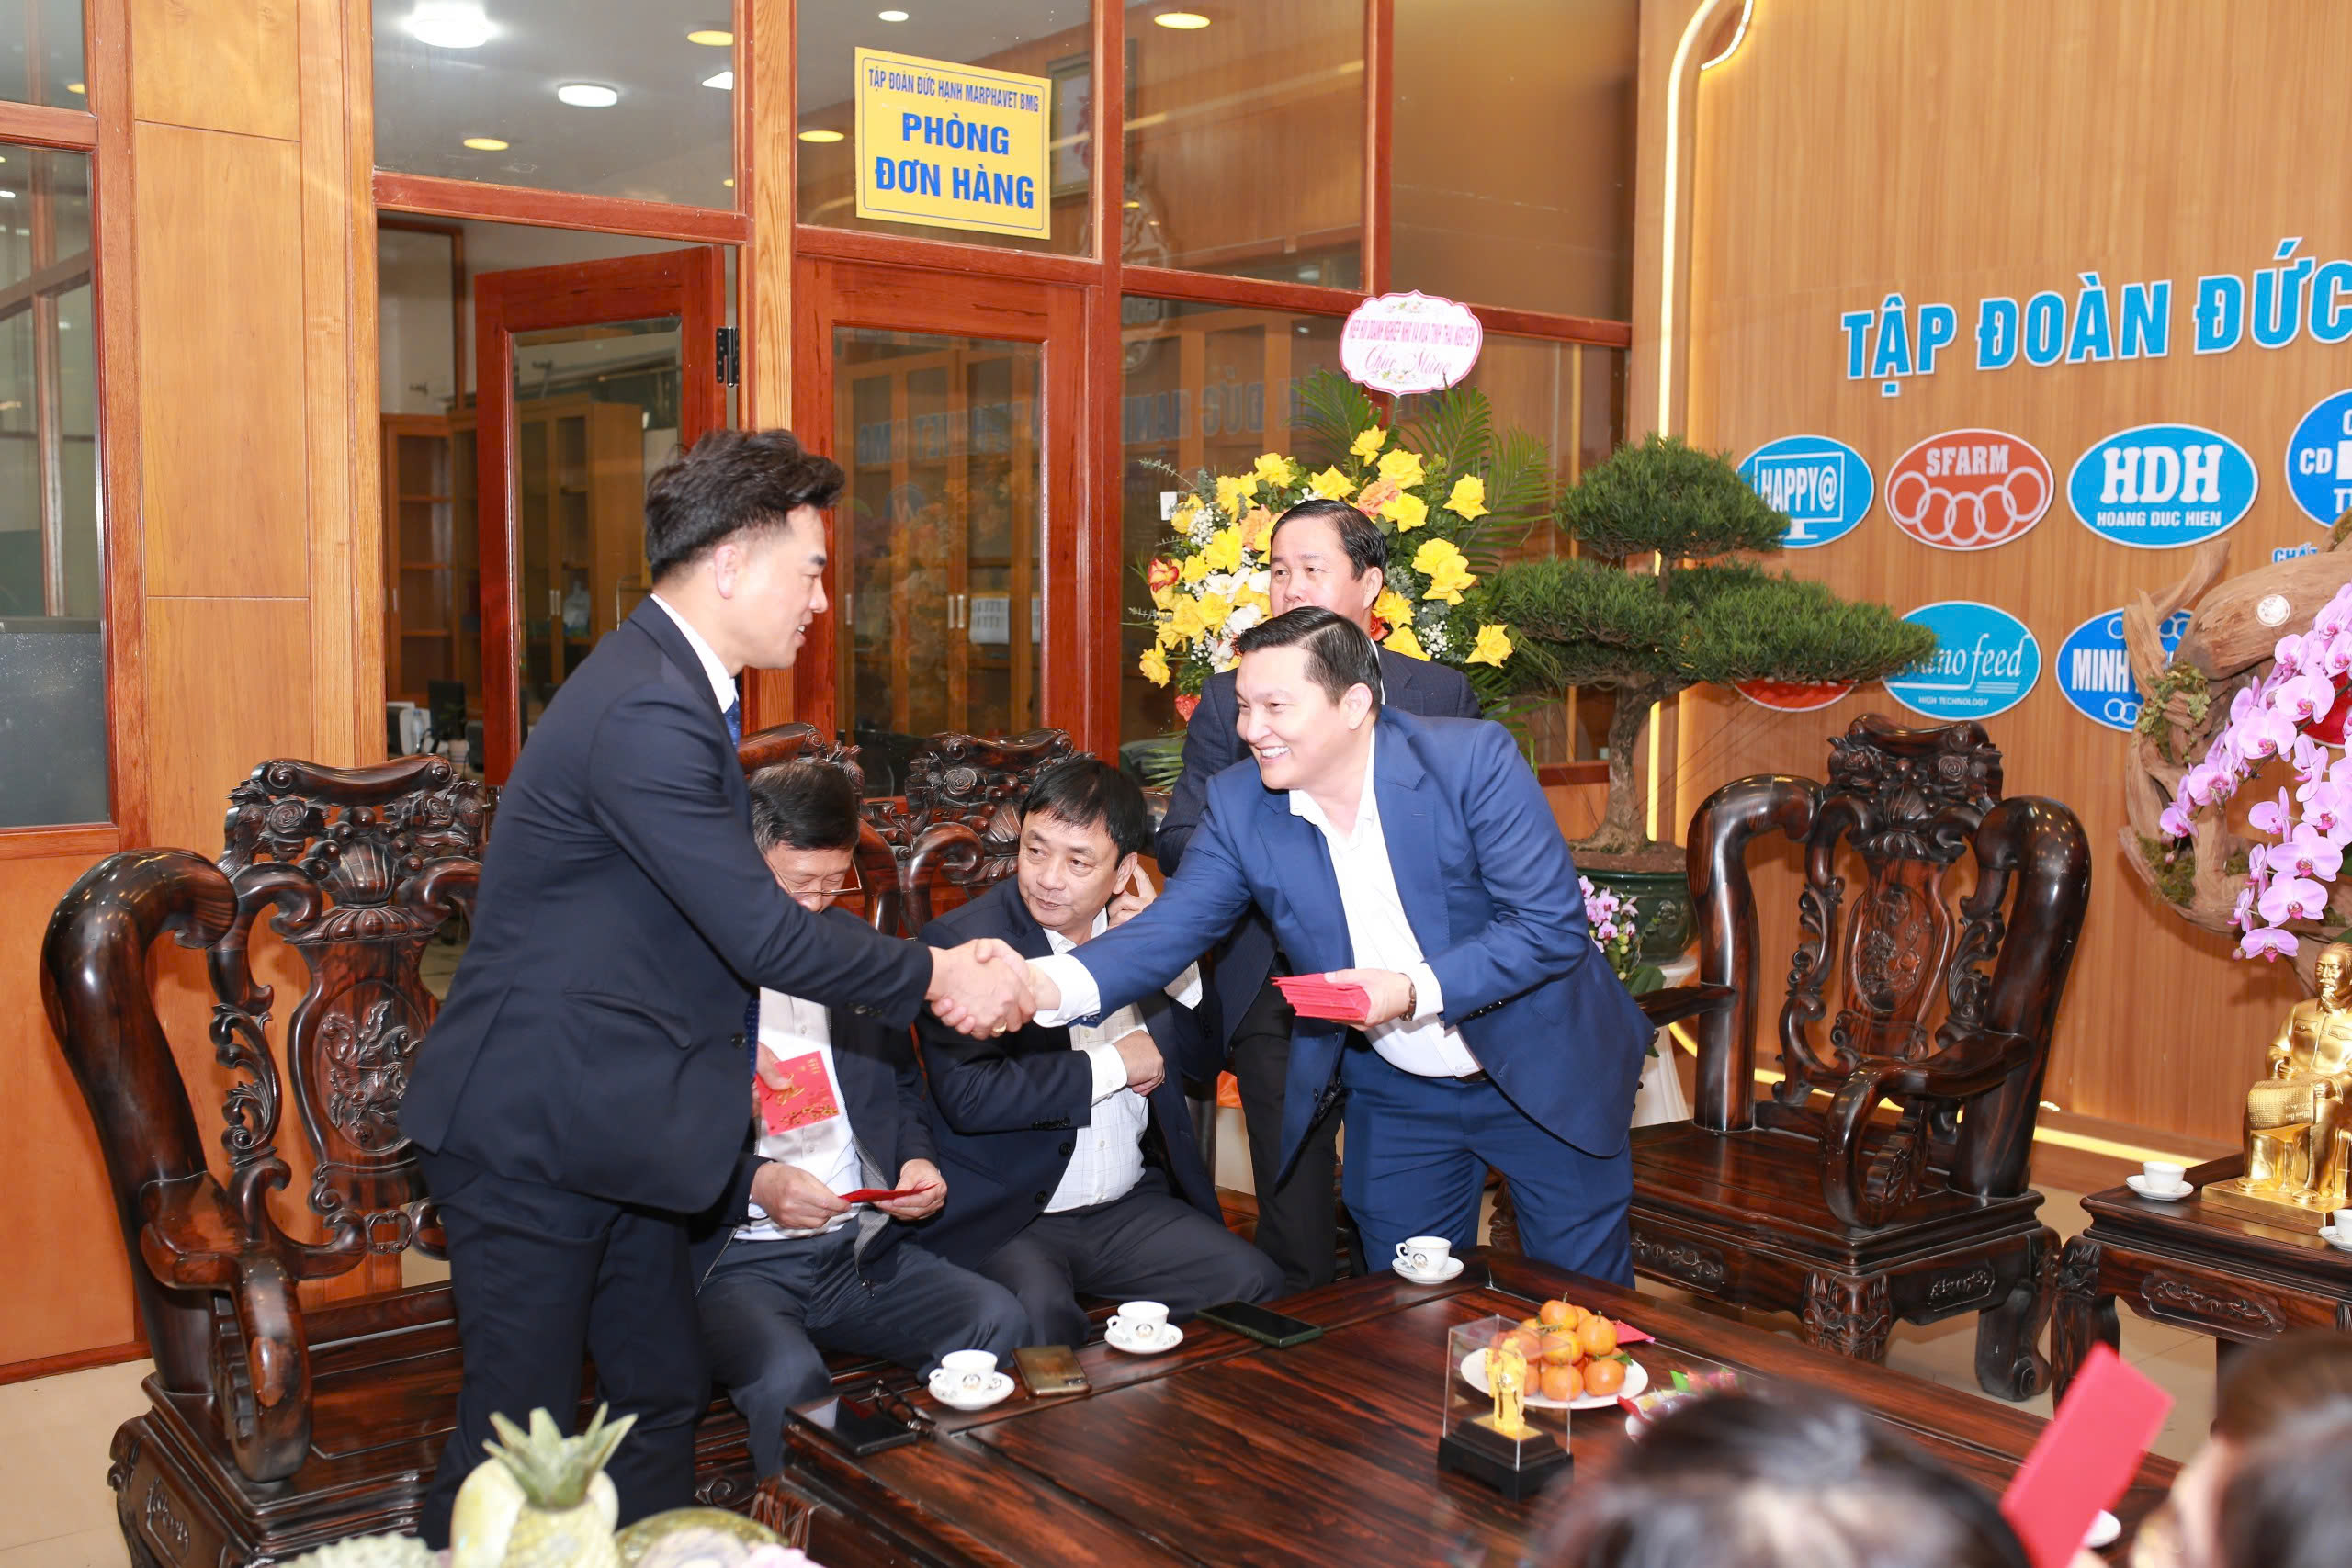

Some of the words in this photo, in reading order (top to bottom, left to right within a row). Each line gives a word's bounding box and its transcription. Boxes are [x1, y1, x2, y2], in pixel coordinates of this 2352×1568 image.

[889, 70, 914, 94] ĐOÀN
[917, 73, 935, 96] ĐỨC
[938, 80, 963, 103] HẠNH
[966, 84, 1018, 109] MARPHAVET
[1020, 94, 1040, 112] BMG
[902, 112, 1010, 155] PHÒNG
[875, 156, 941, 197] ĐƠN
[952, 164, 1035, 209] HÀNG
[1841, 293, 1958, 398] TẬP
[1975, 271, 2172, 371] ĐOÀN
[2193, 237, 2352, 355] ĐỨC
[1926, 445, 2009, 477] SFARM
[2099, 445, 2224, 503] HDH
[2299, 447, 2333, 476] CD
[1761, 465, 1838, 512] HAPPY@
[2096, 511, 2147, 527] HOANG
[2185, 510, 2222, 527] HIEN
[2071, 648, 2130, 694] MINH
